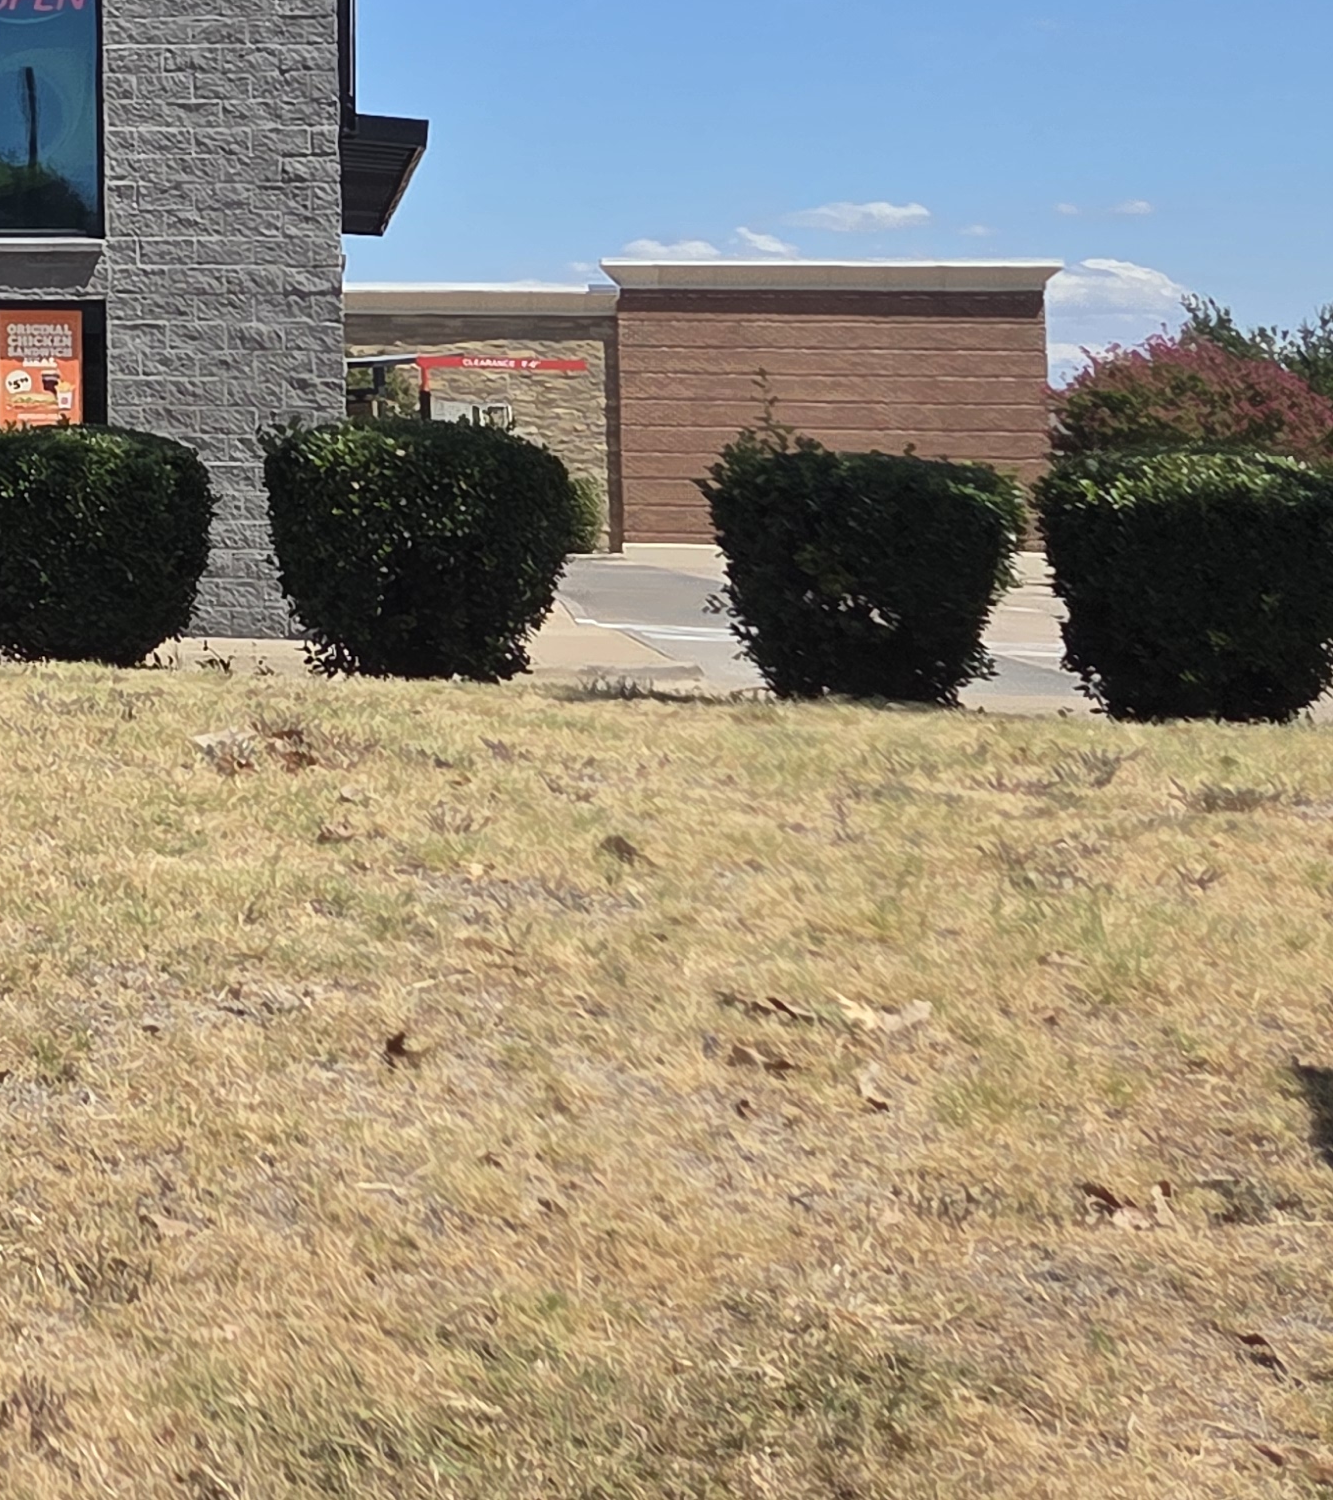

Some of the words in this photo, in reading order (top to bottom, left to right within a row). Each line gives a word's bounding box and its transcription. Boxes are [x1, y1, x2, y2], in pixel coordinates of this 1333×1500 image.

[6, 323, 73, 335] ORIGINAL
[7, 335, 73, 347] CHICKEN
[7, 346, 73, 357] SANDWICH
[22, 357, 58, 367] MEAL
[462, 357, 516, 368] CLEARANCE
